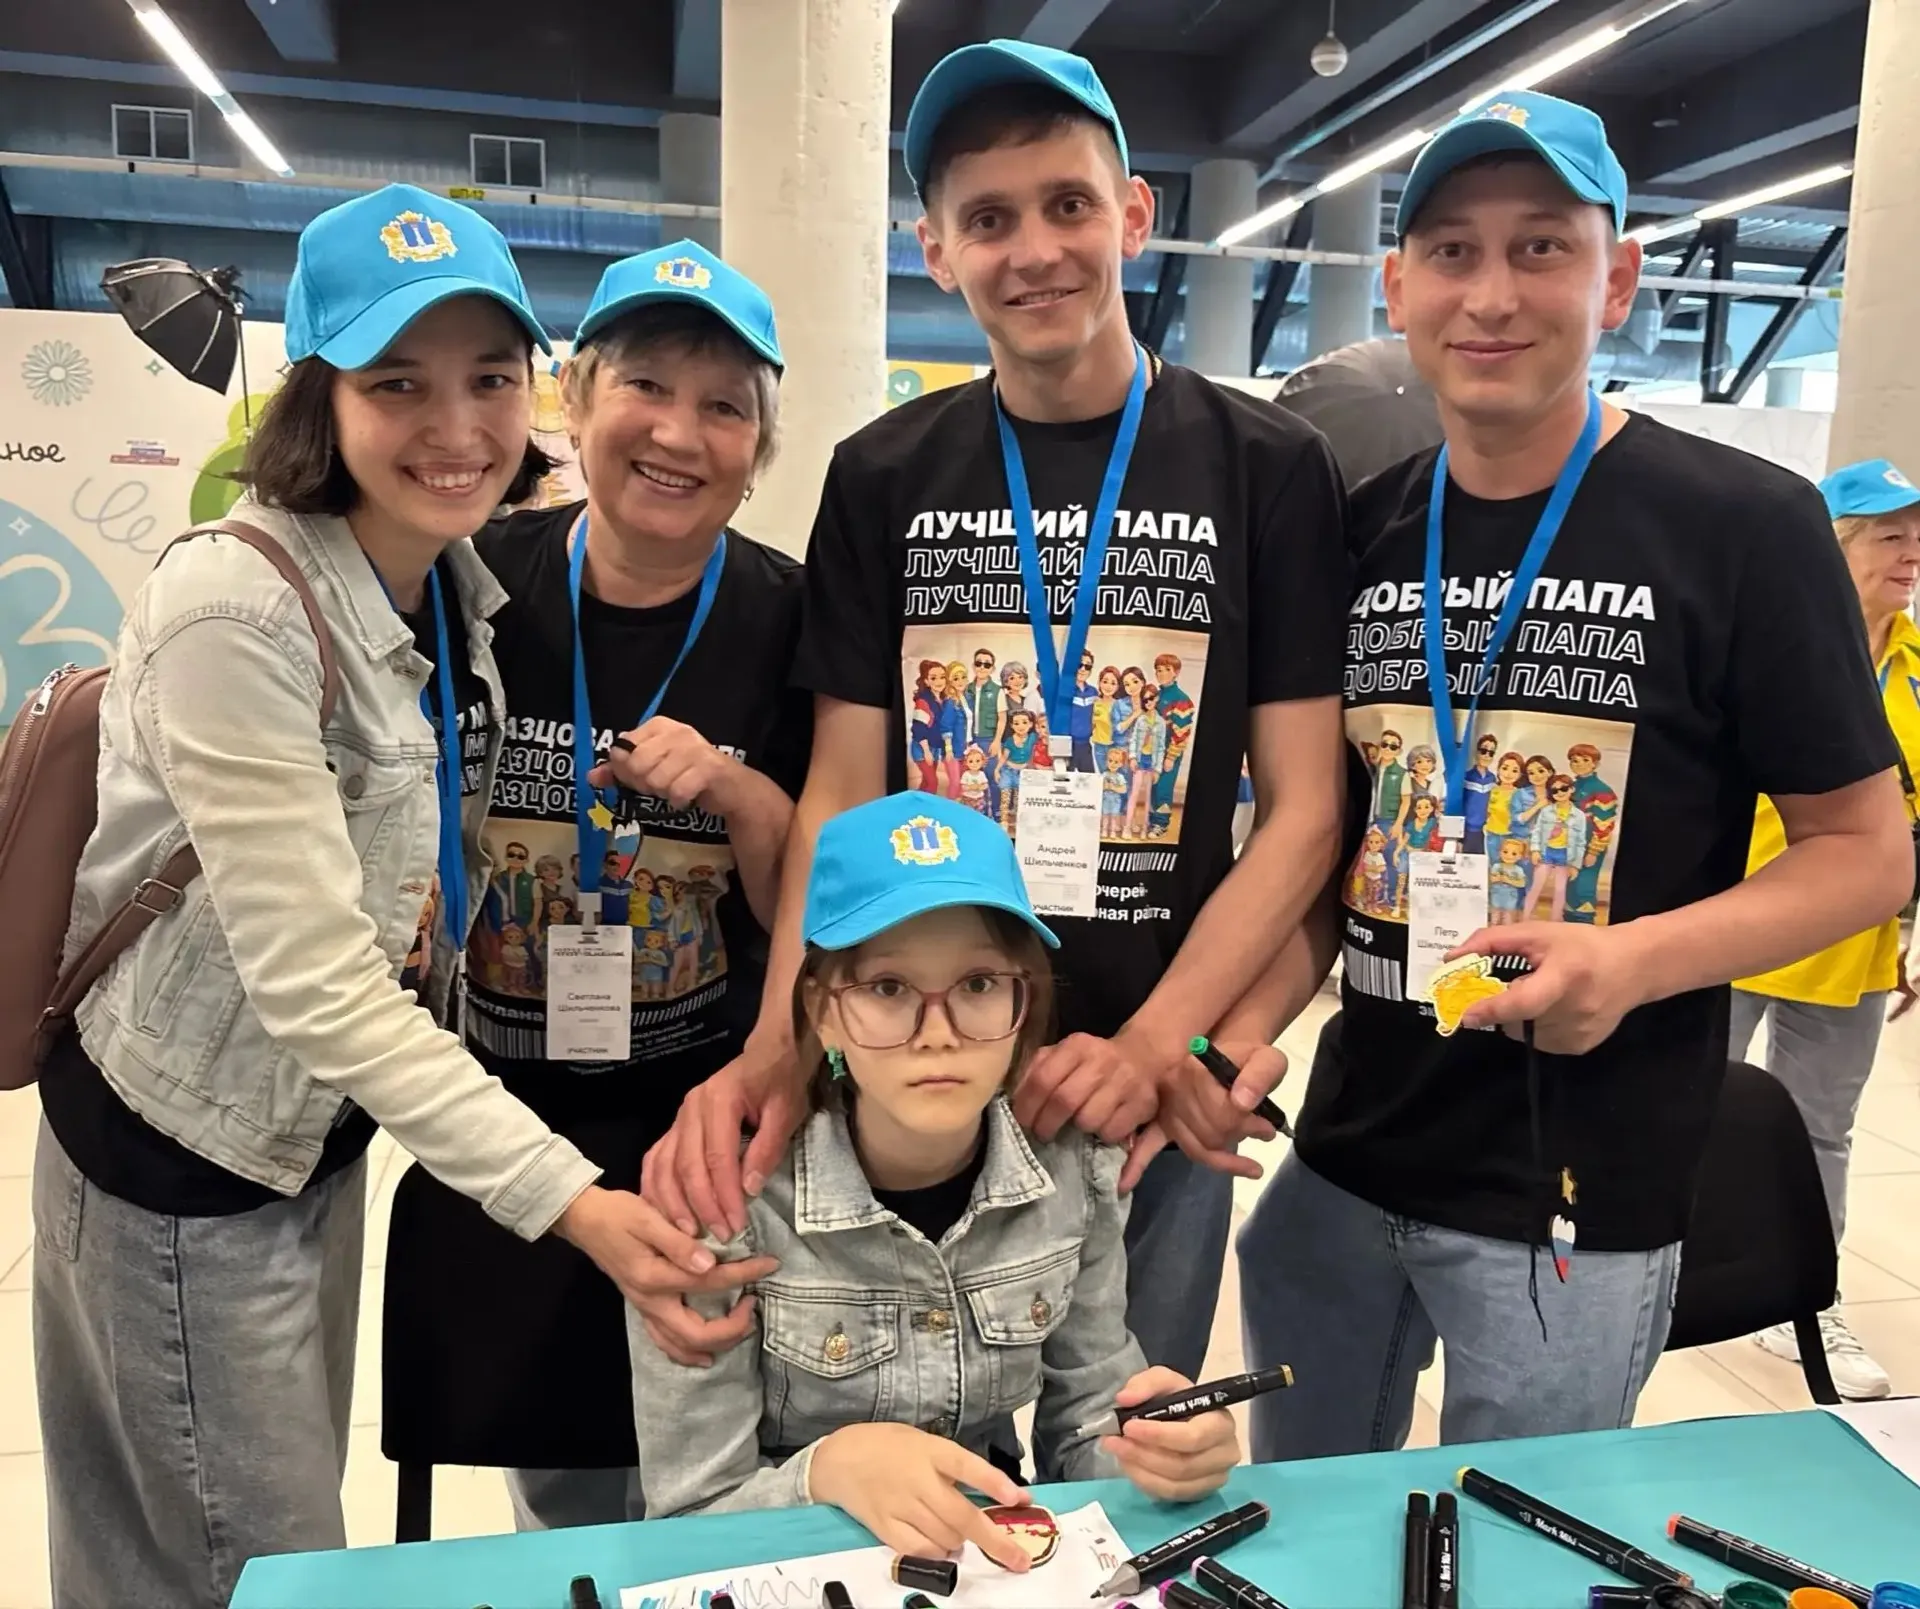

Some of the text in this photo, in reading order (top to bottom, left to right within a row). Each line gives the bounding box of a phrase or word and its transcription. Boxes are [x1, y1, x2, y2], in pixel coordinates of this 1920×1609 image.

[905, 504, 1219, 548] ЛУЧШИЙ ПАПА
[1100, 547, 1216, 585] ПАПА
[1096, 585, 1212, 624] ПАПА
[1525, 577, 1655, 621] ПАПА
[1516, 620, 1646, 666] ПАПА
[1507, 663, 1638, 709] ПАПА
[1037, 843, 1076, 855] Андрей
